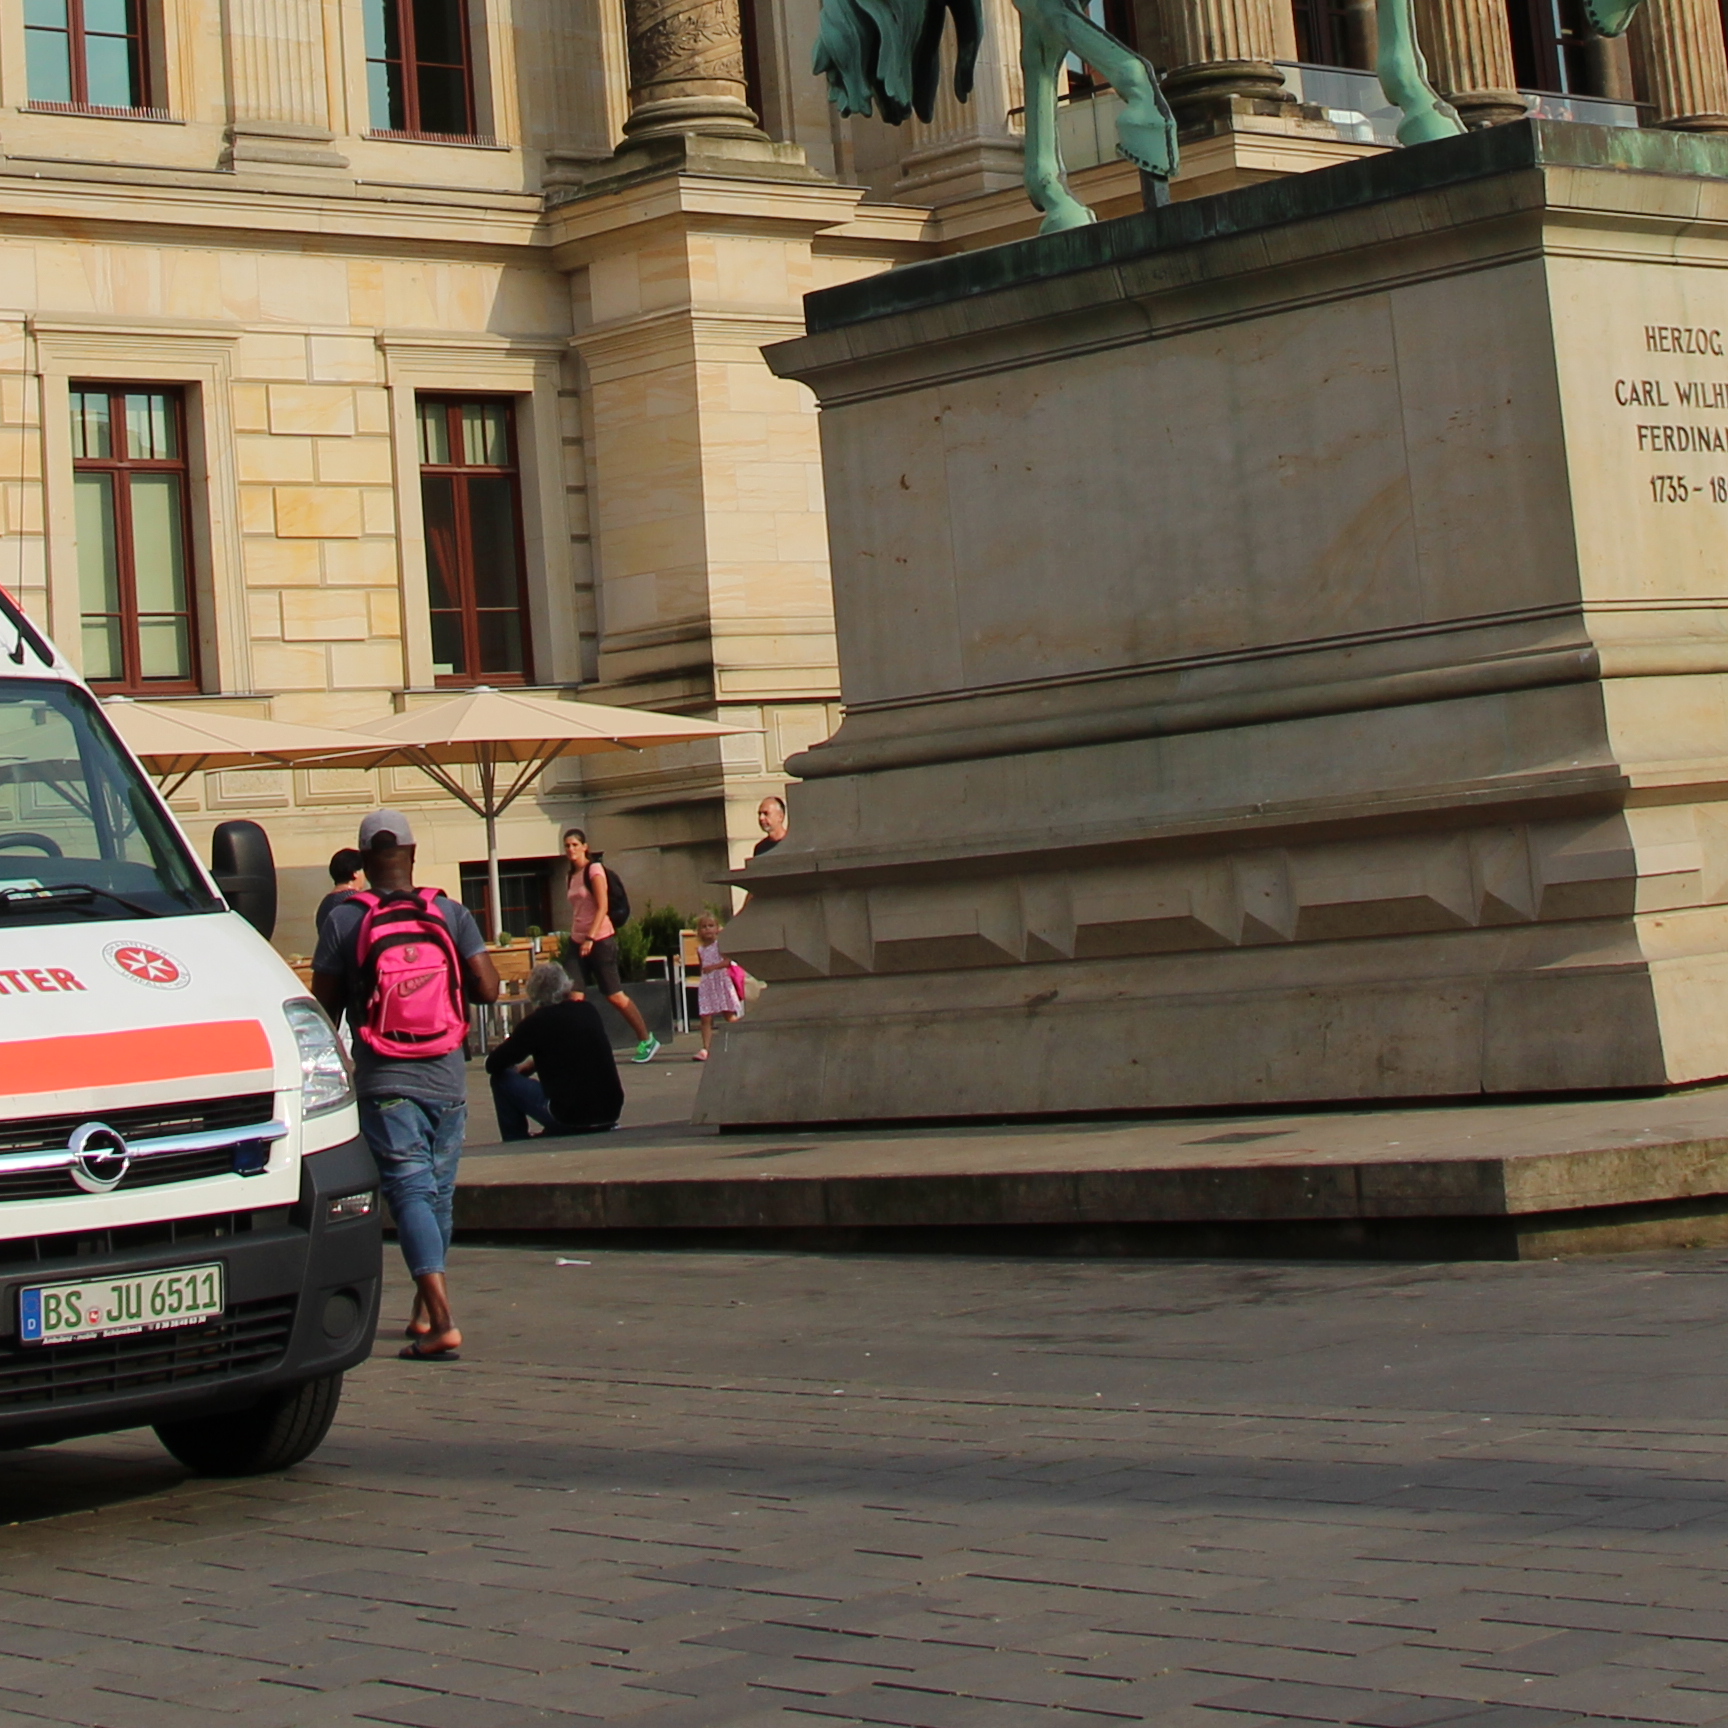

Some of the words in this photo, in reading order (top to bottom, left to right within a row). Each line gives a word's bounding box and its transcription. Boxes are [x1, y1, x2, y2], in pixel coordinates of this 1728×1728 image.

[1644, 325, 1724, 356] HERZOG
[1615, 379, 1669, 407] CARL
[1650, 475, 1689, 503] 1735
[43, 1290, 83, 1332] BS
[106, 1282, 142, 1322] JU
[150, 1272, 218, 1316] 6511
